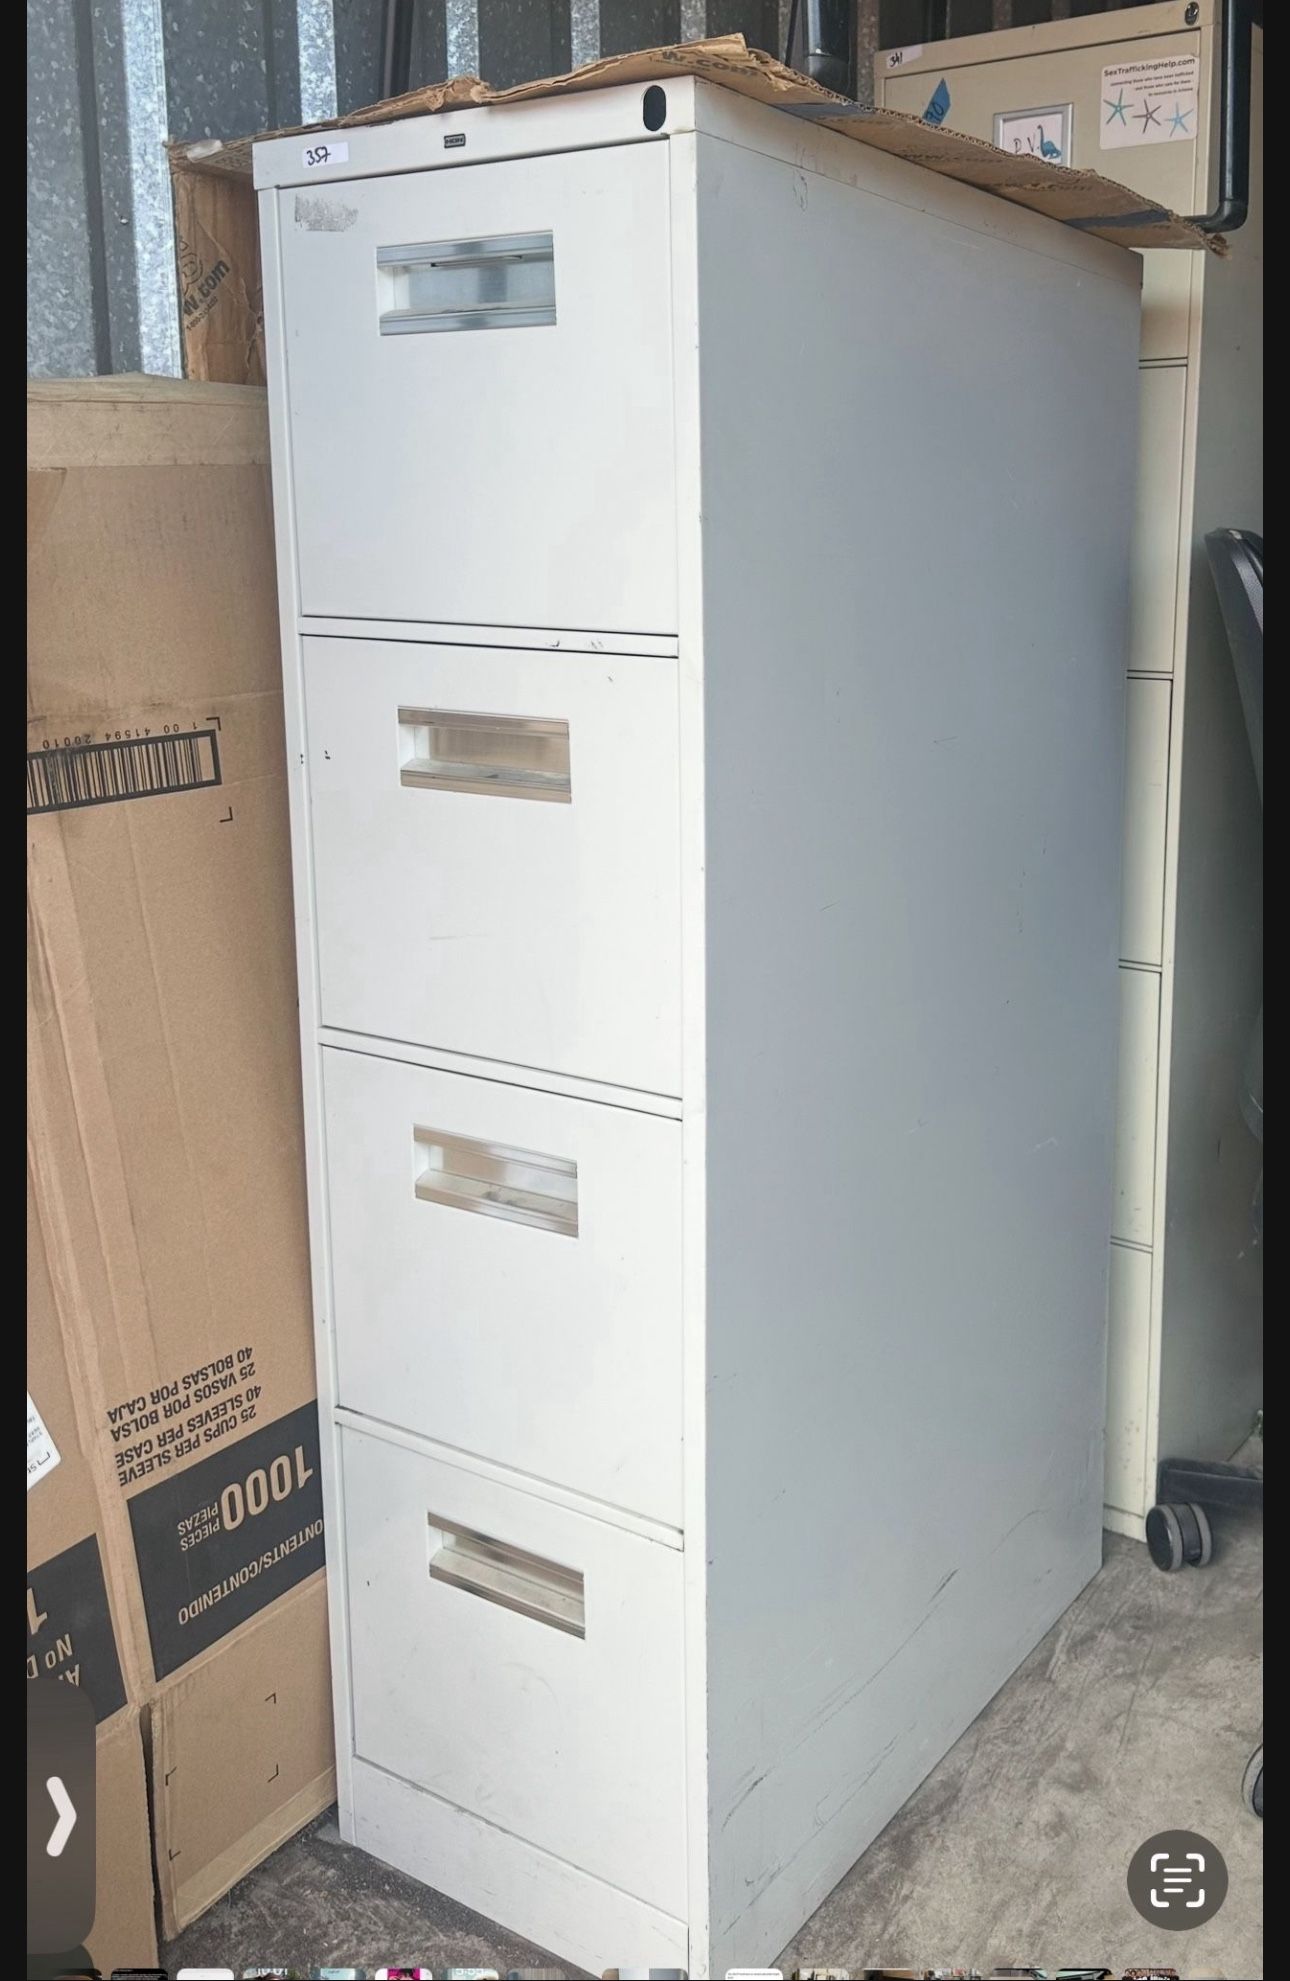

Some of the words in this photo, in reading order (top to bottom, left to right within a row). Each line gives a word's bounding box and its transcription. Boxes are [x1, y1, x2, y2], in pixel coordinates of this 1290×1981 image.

[1104, 58, 1195, 77] SexTraffickingHelp.com
[306, 146, 331, 166] 357
[105, 727, 151, 741] 41594
[163, 723, 180, 734] 00
[193, 722, 198, 730] 1
[42, 733, 92, 750] 20010
[237, 1347, 253, 1363] 40
[182, 1354, 234, 1390] BOLSAS
[240, 1362, 256, 1380] 25
[150, 1381, 179, 1405] POR
[194, 1372, 237, 1403] VASOS
[246, 1385, 262, 1402] 40
[107, 1397, 146, 1424] CAJA
[163, 1394, 191, 1418] POR
[187, 1394, 243, 1433] SLEEVES
[240, 1404, 256, 1423] 25
[110, 1409, 159, 1442] BOLSA
[157, 1424, 184, 1448] PER
[203, 1415, 237, 1443] CUPS
[115, 1439, 153, 1469] CASE
[175, 1434, 200, 1458] PER
[118, 1450, 171, 1487] SLEEVE
[221, 1445, 313, 1531] 1000
[177, 1502, 219, 1536] PIEZAS
[179, 1518, 220, 1551] PIECES
[178, 1519, 324, 1625] ONTENTS/CONTENIDO
